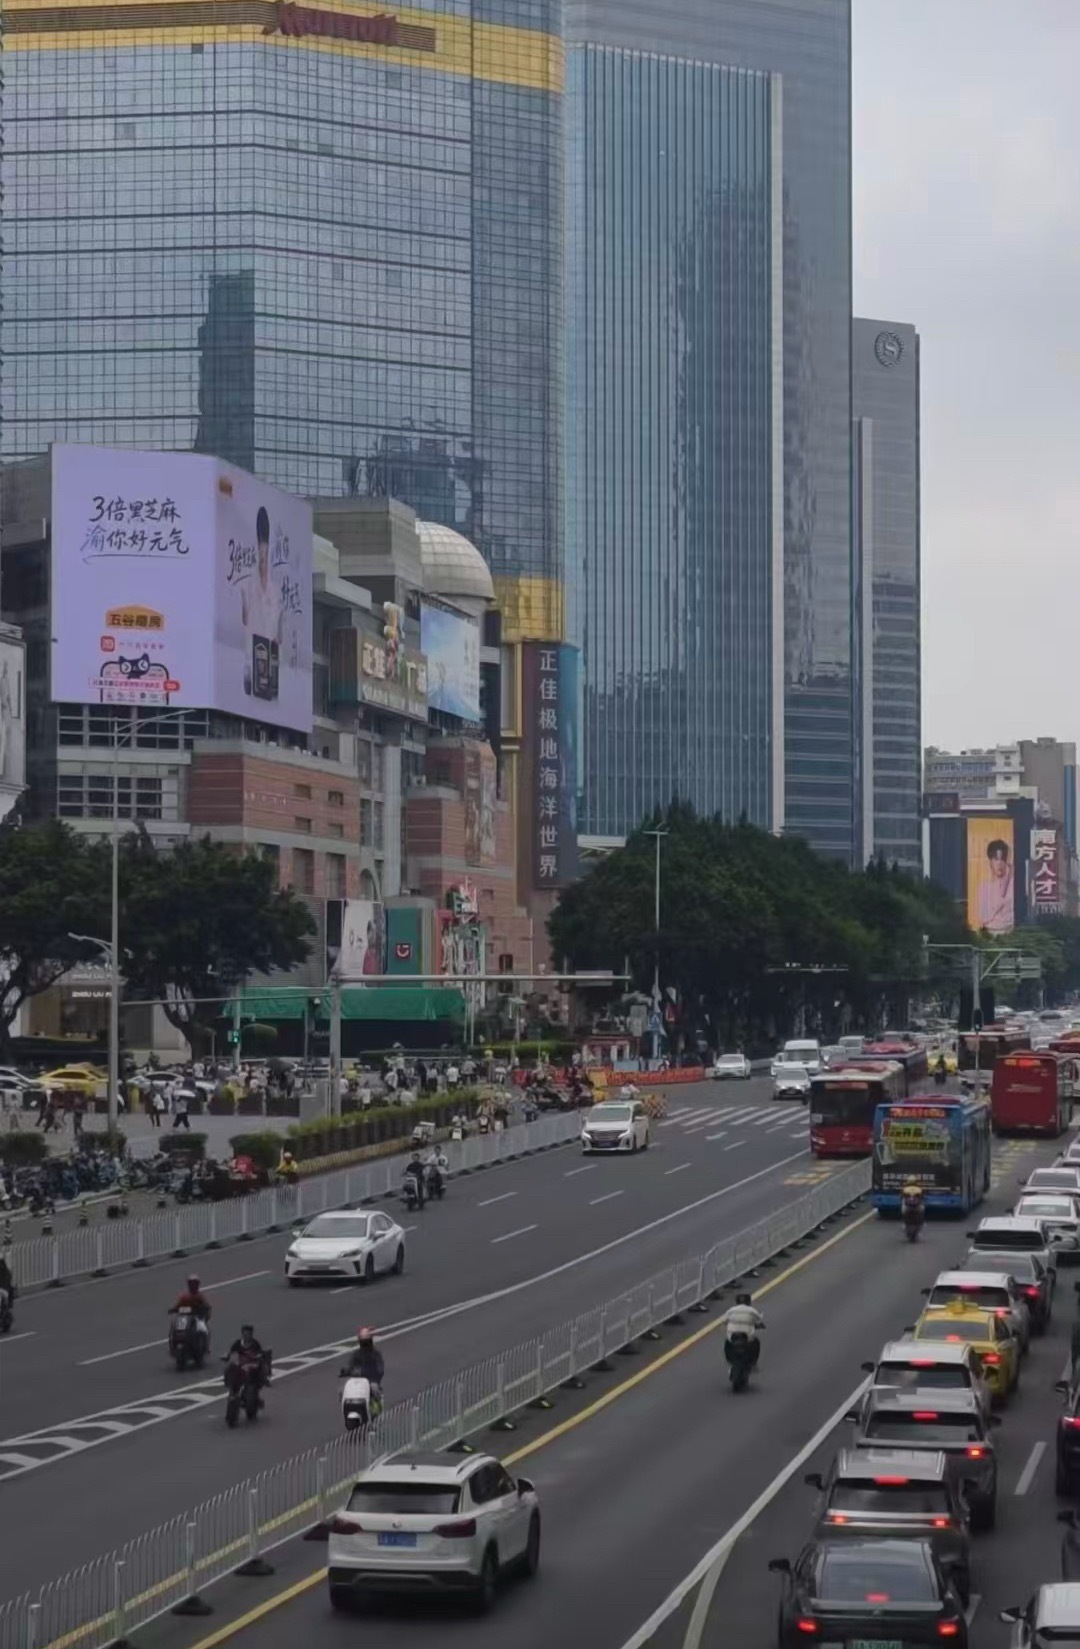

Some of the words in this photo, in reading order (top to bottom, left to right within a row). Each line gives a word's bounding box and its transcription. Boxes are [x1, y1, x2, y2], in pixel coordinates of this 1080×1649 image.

[89, 496, 181, 523] 3倍黑芝麻
[539, 649, 558, 878] 正佳极地海洋世界
